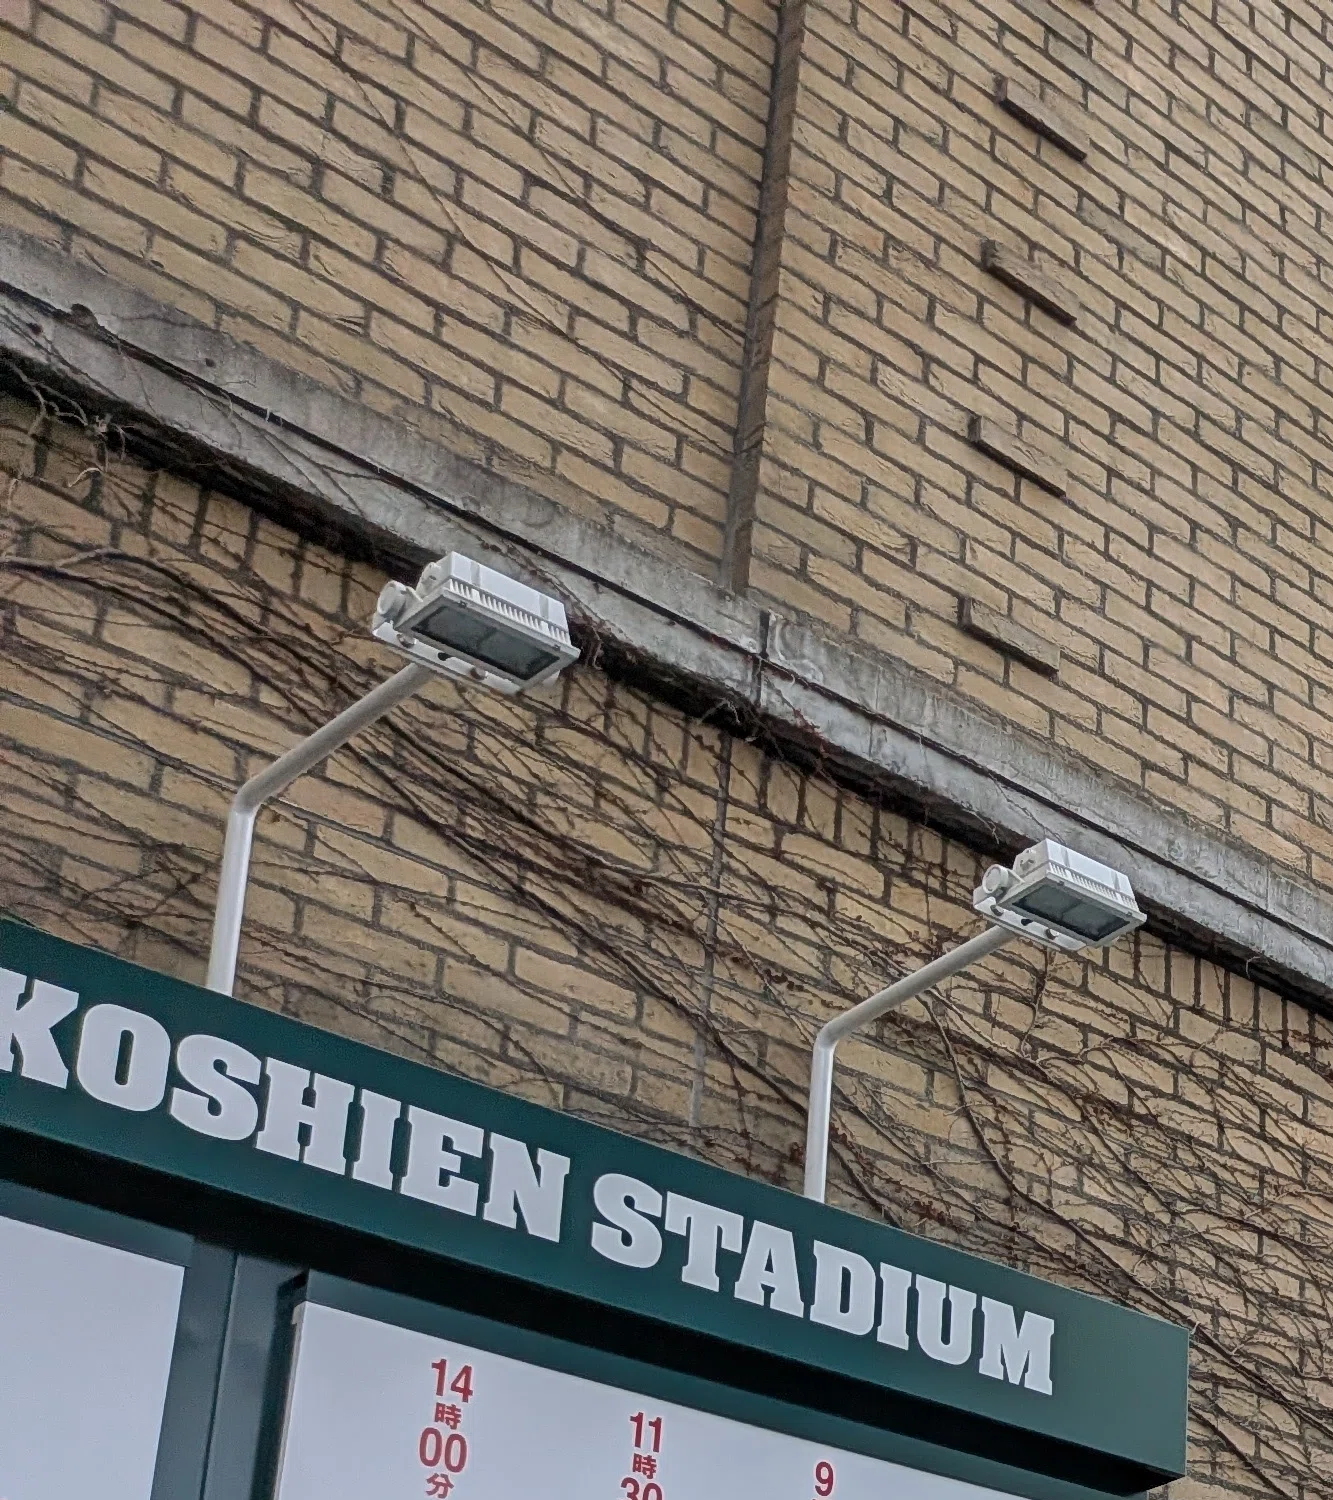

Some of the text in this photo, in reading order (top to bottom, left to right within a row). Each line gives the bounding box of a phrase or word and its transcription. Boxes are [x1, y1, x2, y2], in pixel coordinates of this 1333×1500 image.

[0, 966, 1056, 1396] KOSHIEN STADIUM
[417, 1357, 475, 1500] 14時00分
